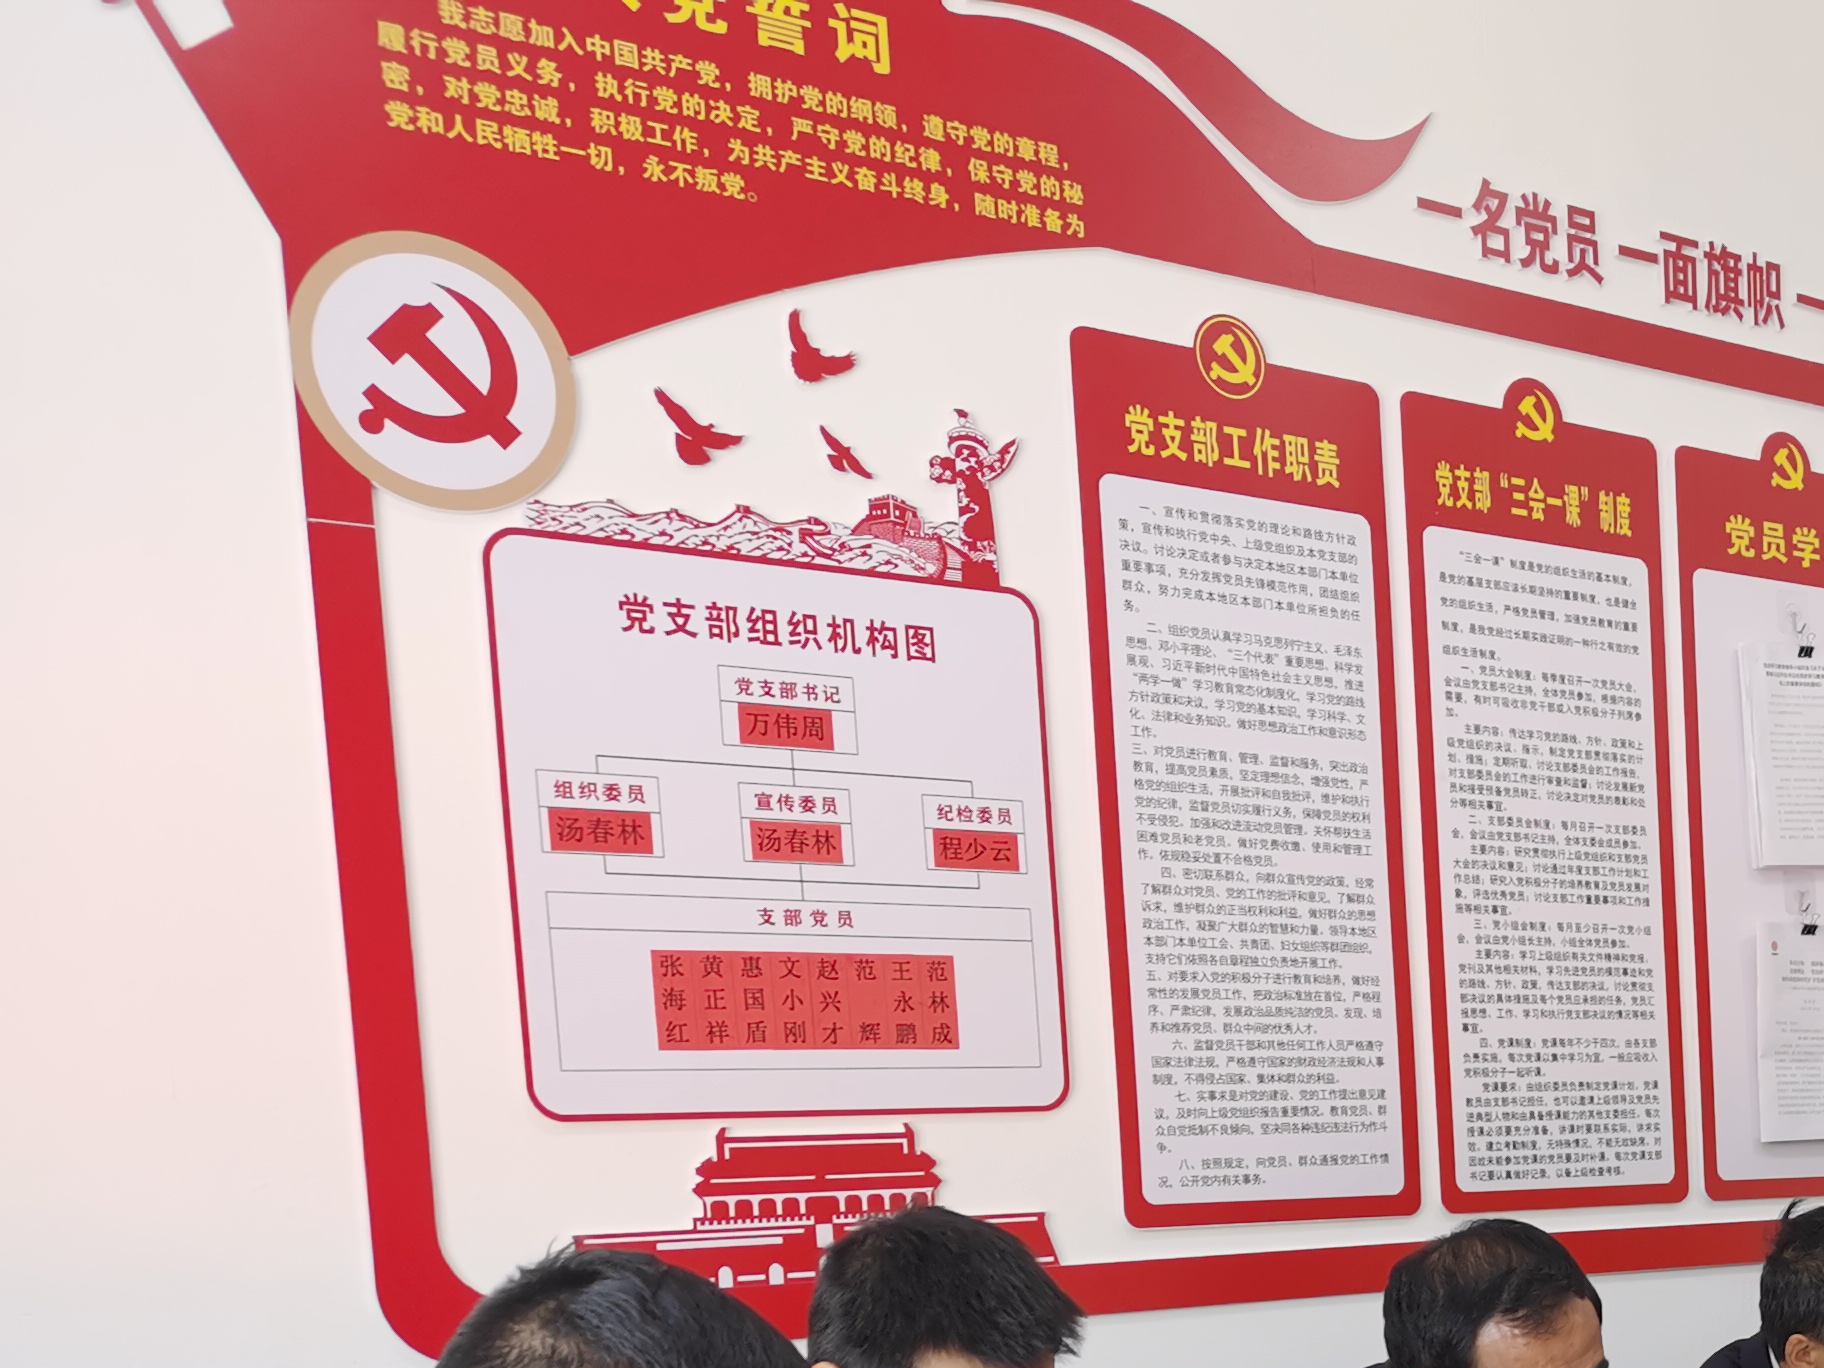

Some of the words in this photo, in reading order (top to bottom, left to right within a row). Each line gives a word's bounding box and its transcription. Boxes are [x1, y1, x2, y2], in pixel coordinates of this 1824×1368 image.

[376, 20, 1085, 206] 履行党员义务，执行党的决定，严守党的纪律，保守党的秘
[381, 61, 1086, 239] 密，对党忠诚，积极工作，为共产主义奋斗终身，随时准备为
[384, 100, 759, 204] 党和人民牺牲一切，永不叛党。
[1416, 178, 1604, 285] 一名党员
[1618, 231, 1785, 330] 一面旗帜
[1125, 404, 1341, 489] 党支部工作职责
[618, 593, 937, 663] 党支部组织机构图
[734, 677, 841, 704] 党支部书记
[745, 711, 826, 742] 万伟周
[553, 779, 647, 804] 组织委员
[754, 792, 838, 816] 宣传委员
[556, 815, 645, 846] 汤春林
[936, 804, 1013, 826] 纪检委员
[756, 827, 838, 856] 汤春林
[938, 835, 1013, 864] 程少云
[757, 908, 854, 928] 支部党员
